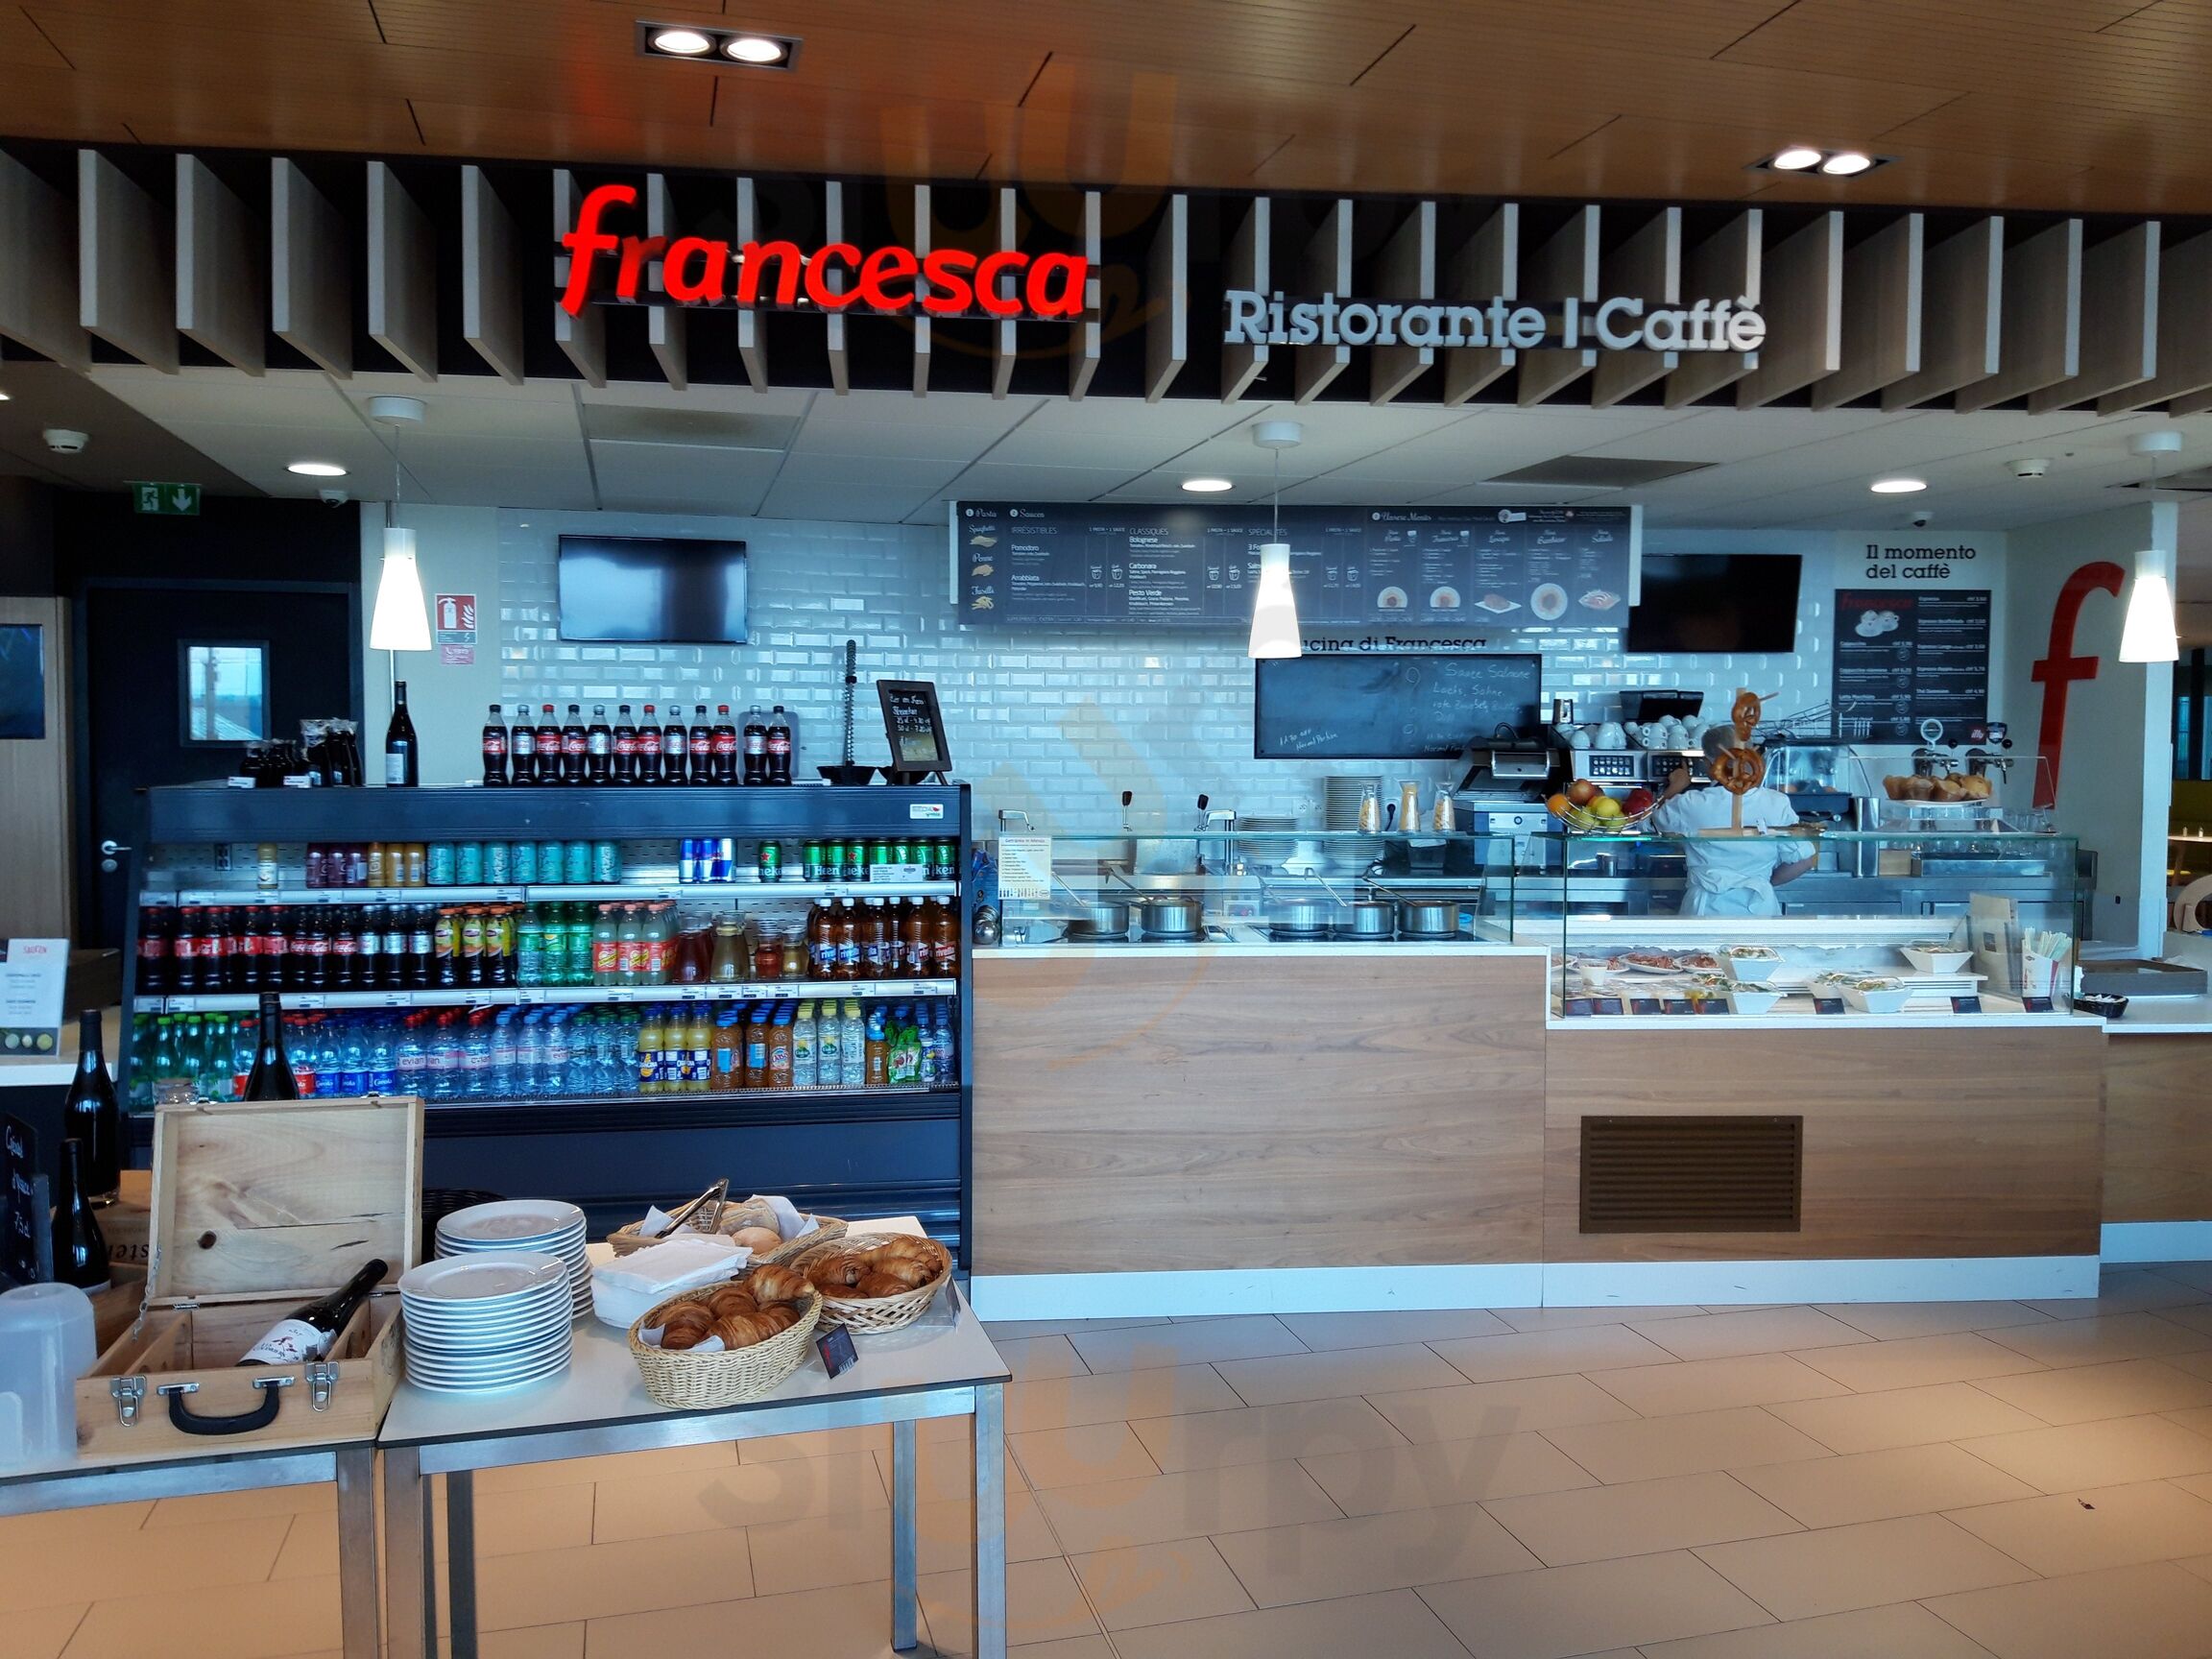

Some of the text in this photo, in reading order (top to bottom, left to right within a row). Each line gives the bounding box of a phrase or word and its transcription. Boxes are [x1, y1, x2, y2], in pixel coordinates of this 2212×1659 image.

[561, 184, 1088, 317] francesca
[1224, 289, 1547, 349] Ristorante
[1596, 294, 1767, 351] Caffè
[1129, 537, 1160, 545] Bolognese
[1866, 544, 1977, 560] Il momento
[1128, 562, 1158, 570] Carbonara
[1865, 563, 1952, 579] del caffè
[1128, 589, 1163, 597] Pesto Verde
[1359, 637, 1380, 651] di
[1384, 636, 1487, 650] Francesca
[373, 1077, 393, 1088] Carola
